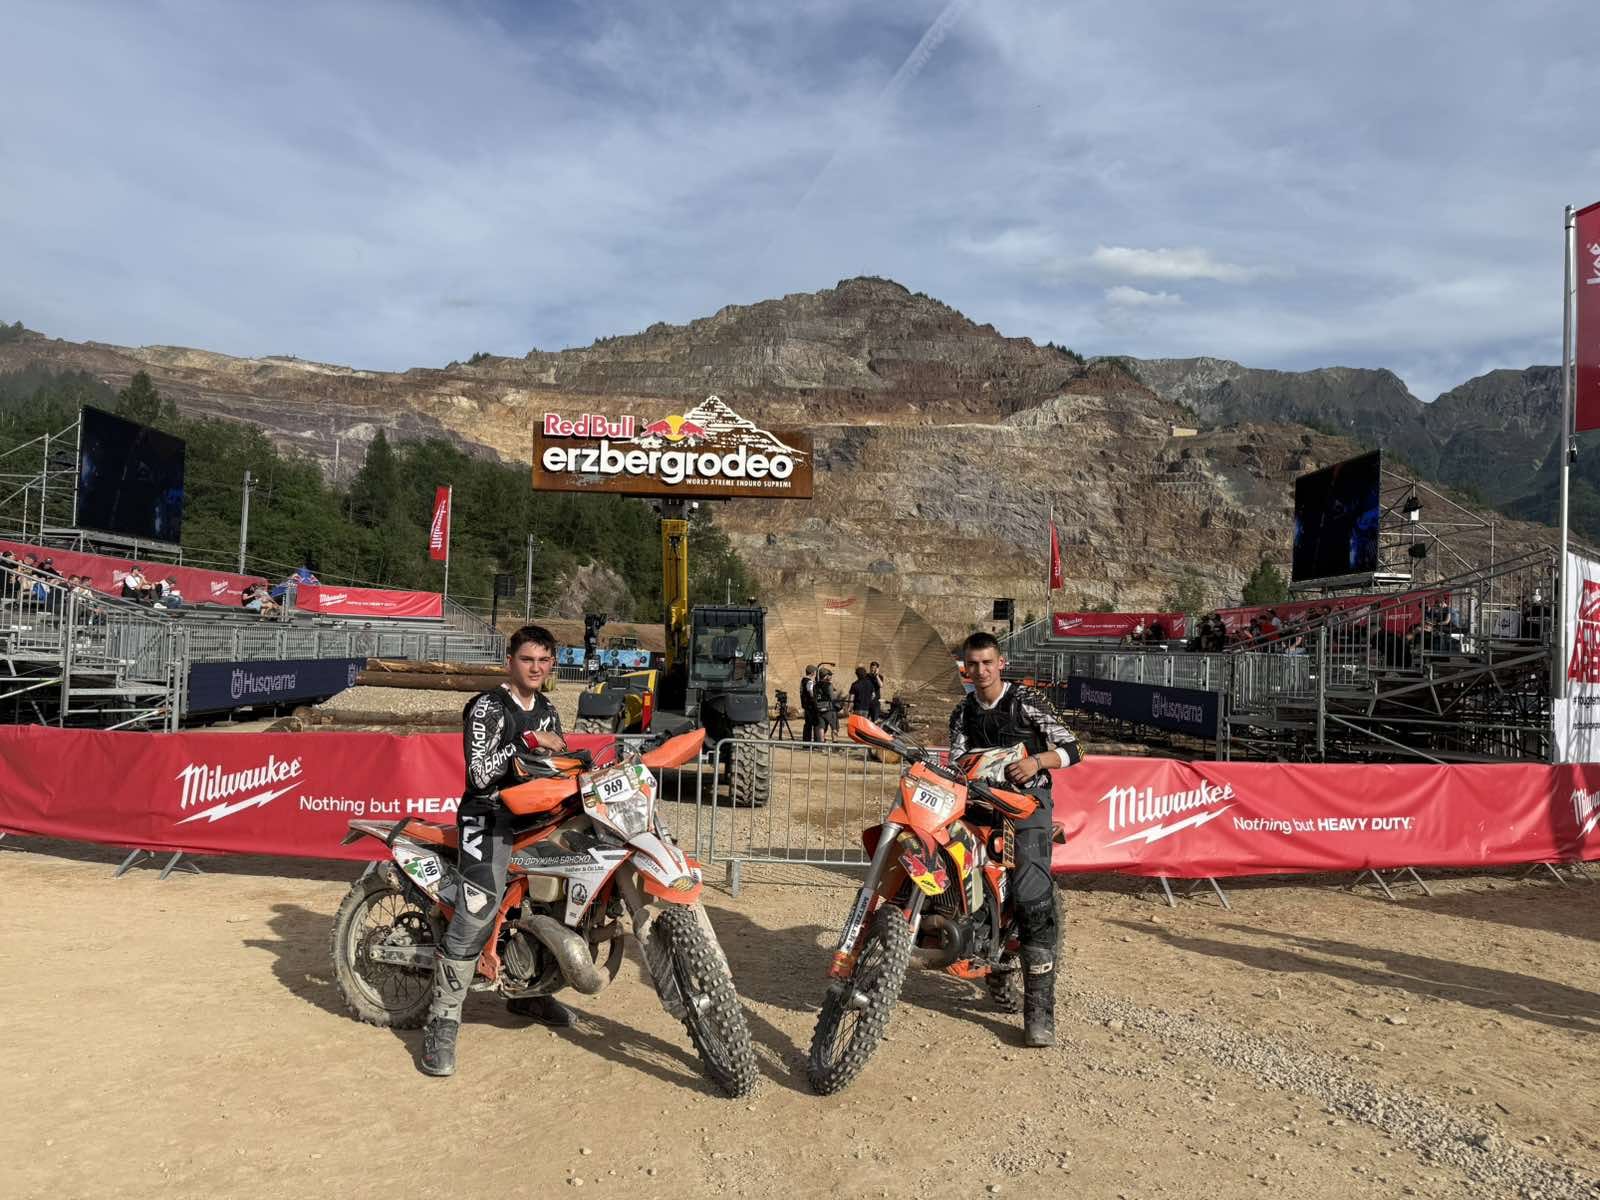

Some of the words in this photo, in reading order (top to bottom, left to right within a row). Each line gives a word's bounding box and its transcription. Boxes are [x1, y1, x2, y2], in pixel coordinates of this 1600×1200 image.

[543, 413, 589, 437] Red
[591, 415, 635, 438] Bull
[542, 440, 794, 485] erzbergrodeo
[686, 478, 709, 486] WORLD
[736, 480, 762, 488] ENDURO
[763, 481, 792, 489] SUPREME
[243, 672, 297, 695] Husqvarna
[1159, 695, 1204, 723] Husqvarna
[175, 754, 303, 811] Milwaukee
[603, 778, 624, 796] 969
[299, 795, 365, 816] Nothing
[369, 797, 400, 813] but
[919, 791, 938, 808] 970
[1097, 779, 1236, 833] Milwaukee
[1232, 816, 1292, 835] Nothing
[1294, 818, 1316, 832] but
[1317, 817, 1368, 832] HEAVY
[423, 860, 438, 877] 969
